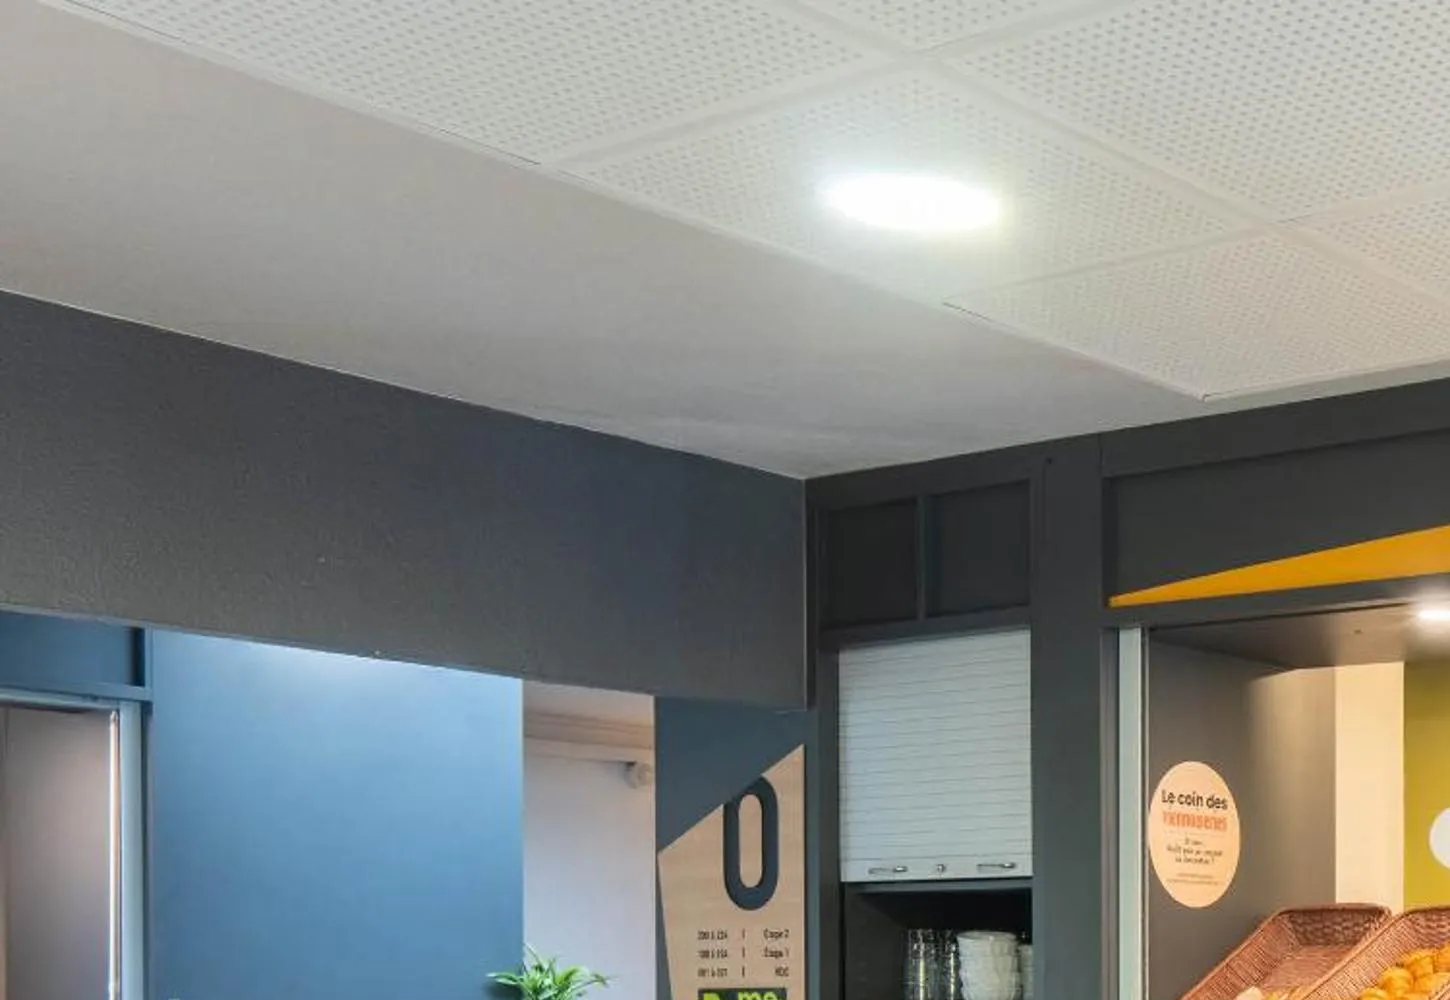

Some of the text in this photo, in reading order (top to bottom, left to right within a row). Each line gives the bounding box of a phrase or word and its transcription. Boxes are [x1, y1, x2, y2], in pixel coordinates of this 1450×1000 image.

[1162, 789, 1228, 810] Le coin des
